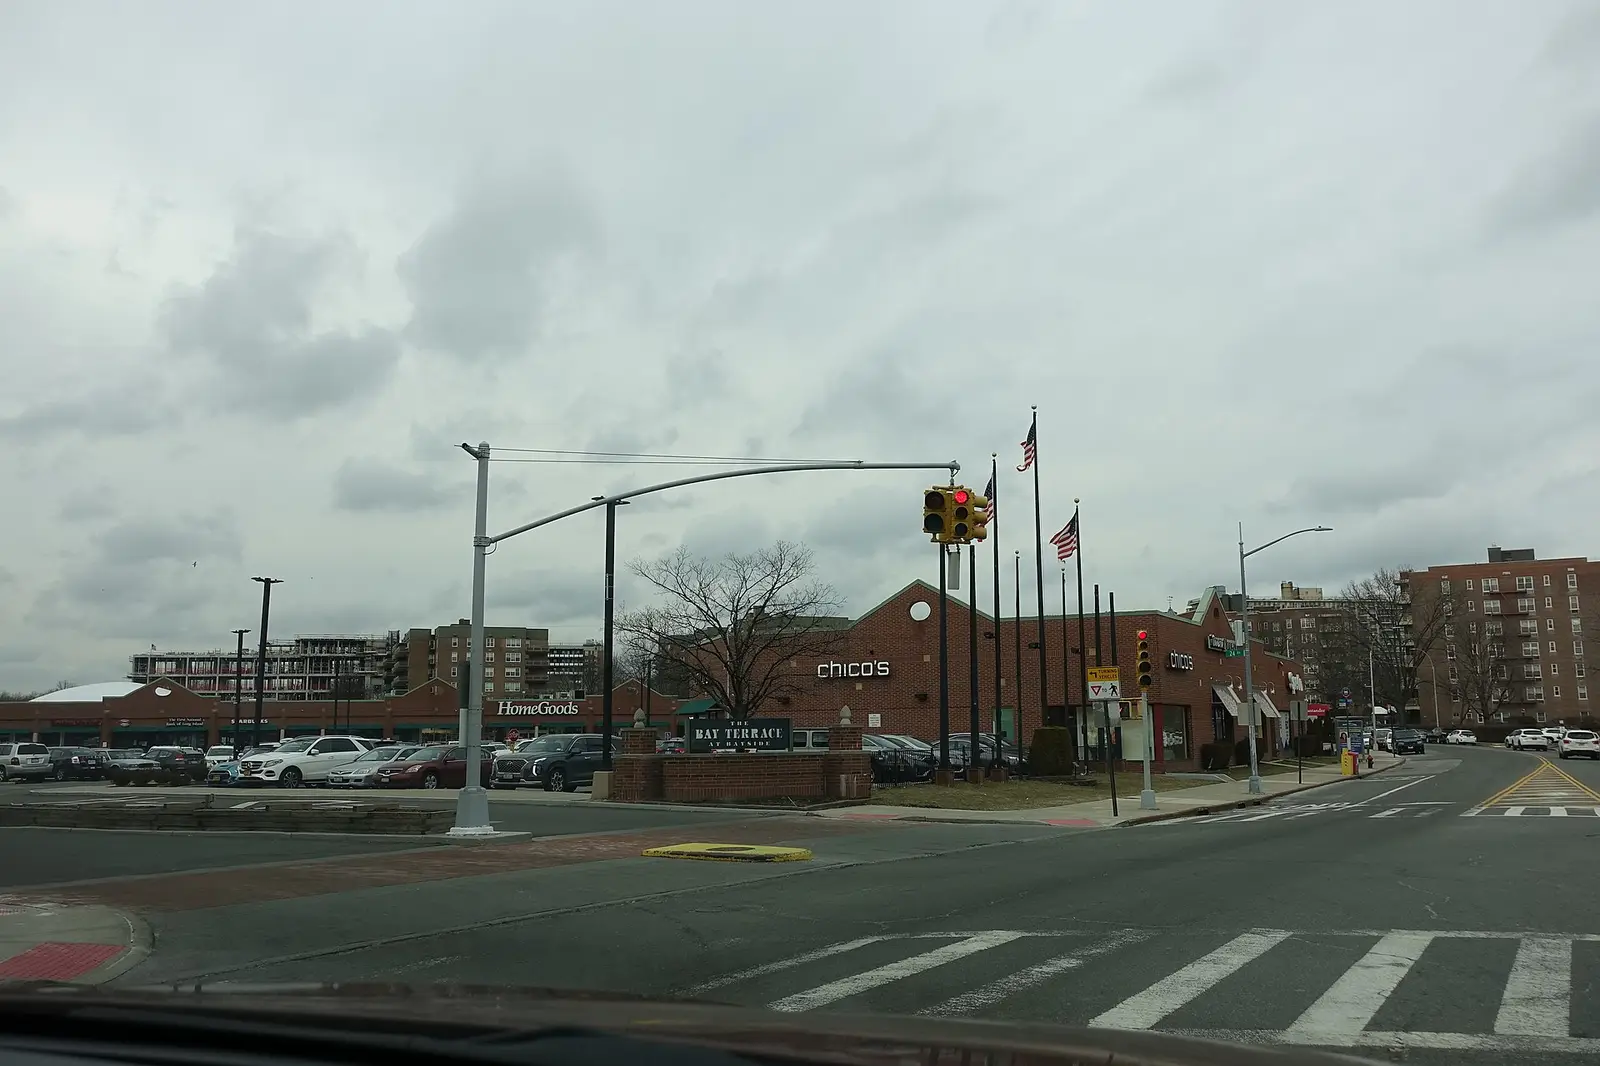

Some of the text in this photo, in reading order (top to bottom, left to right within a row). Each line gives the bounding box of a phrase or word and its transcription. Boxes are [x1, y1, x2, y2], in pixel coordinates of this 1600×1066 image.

[817, 660, 890, 678] chico's
[497, 701, 580, 716] HomeGoods
[695, 728, 784, 740] BAY TERRACE
[726, 740, 771, 748] BAYSIDE
